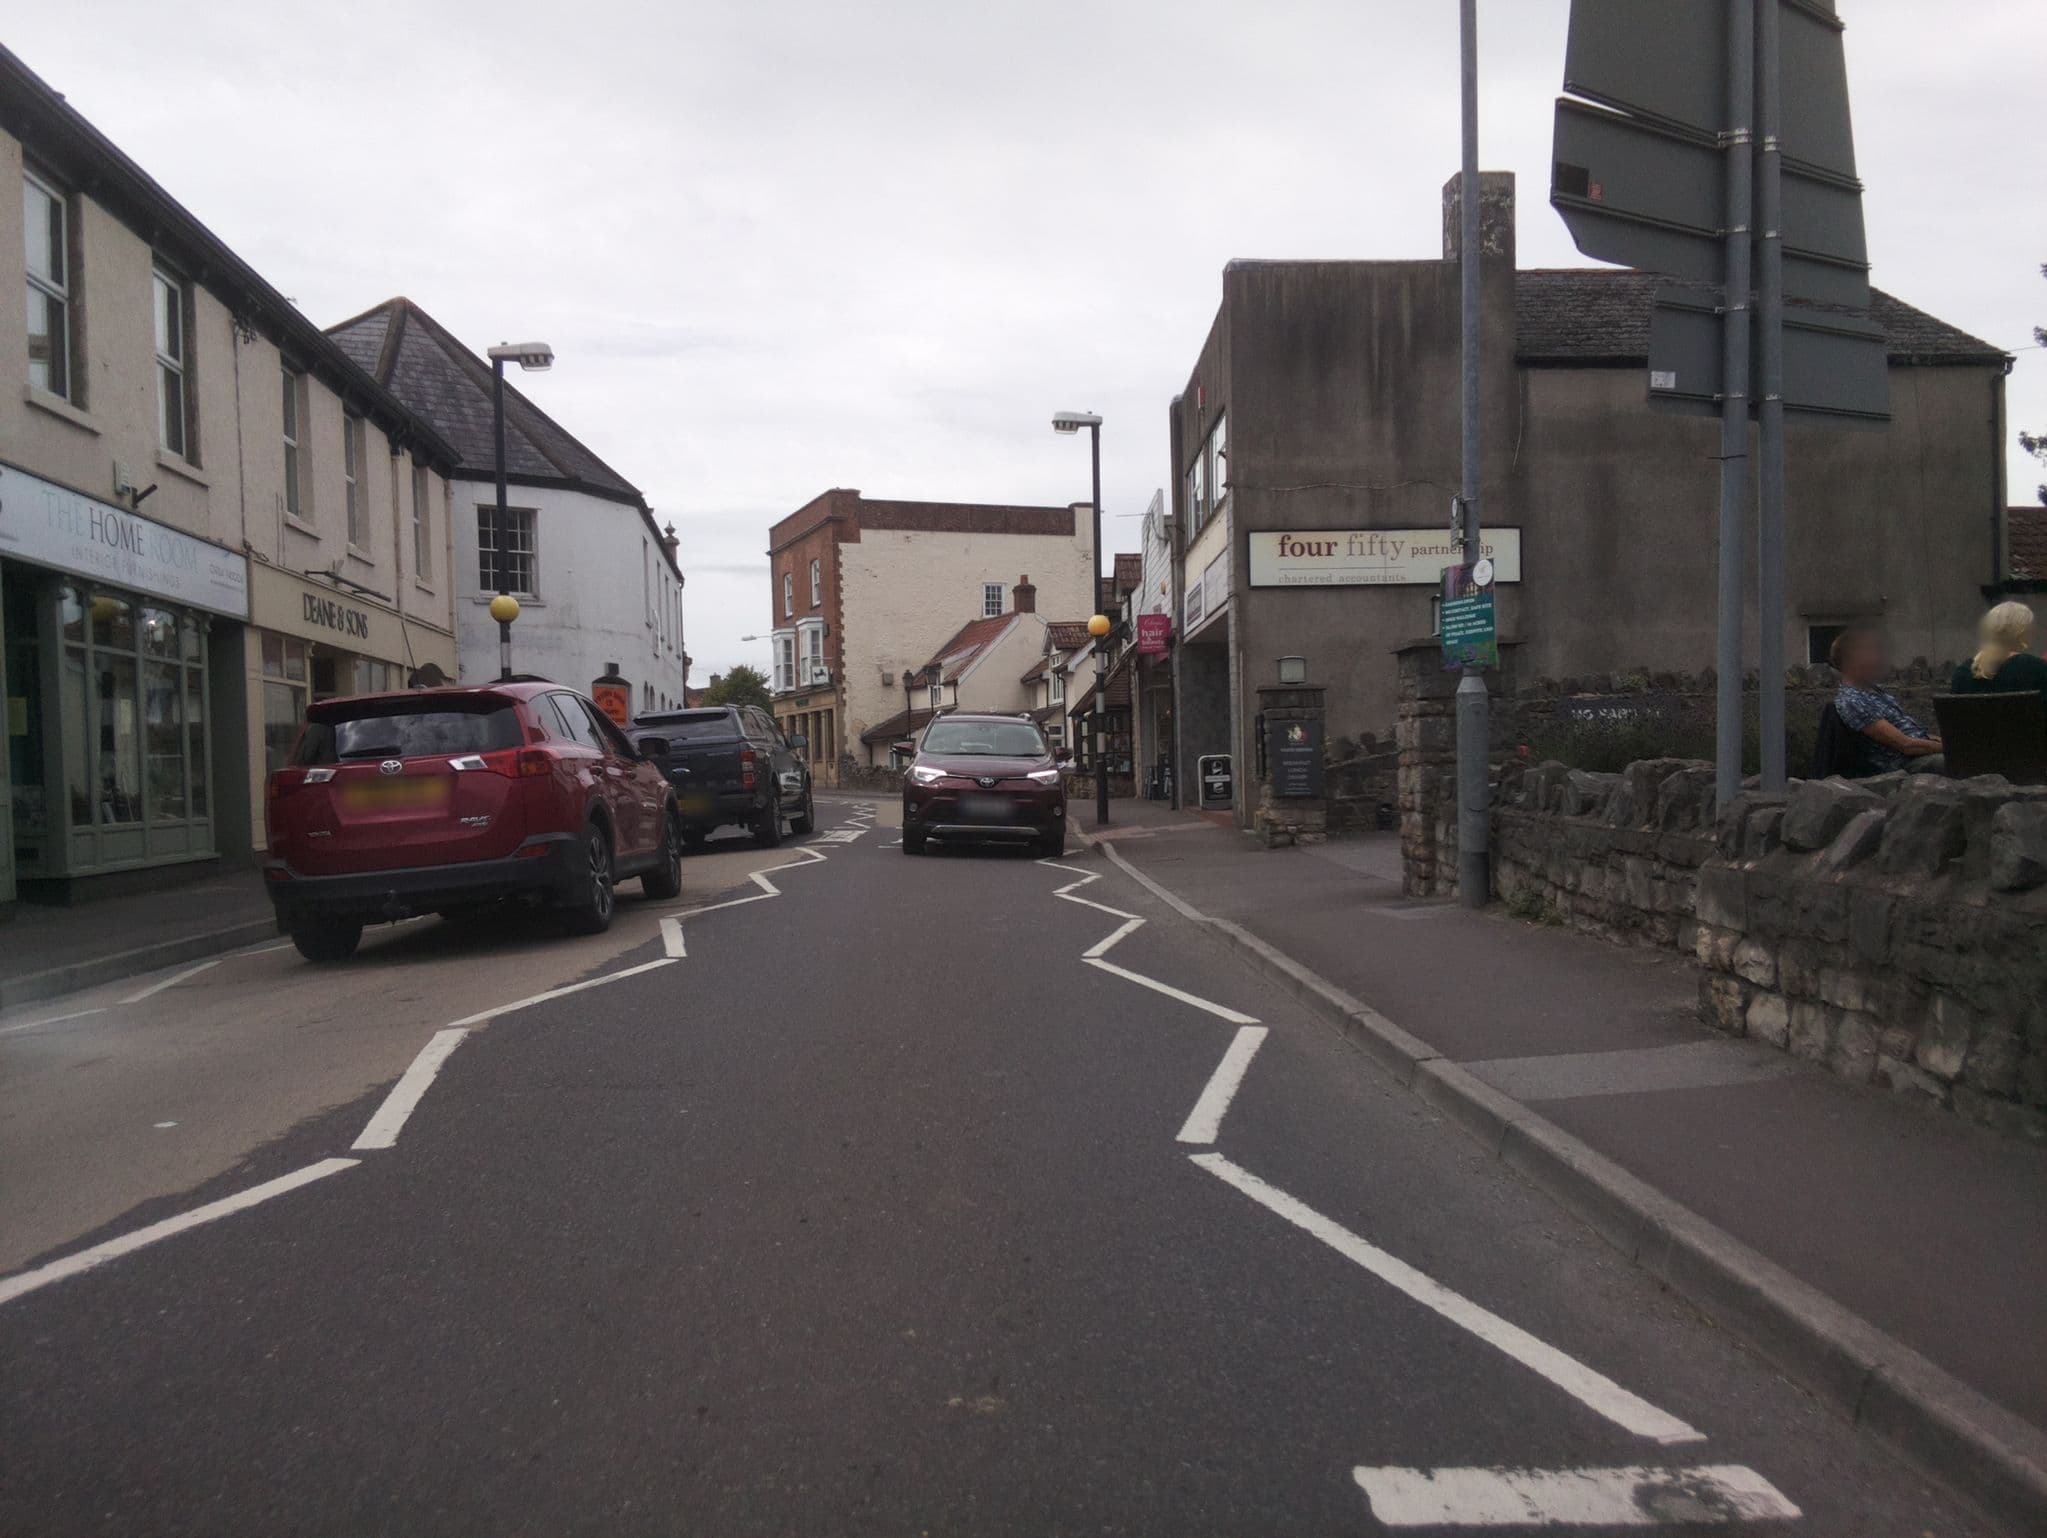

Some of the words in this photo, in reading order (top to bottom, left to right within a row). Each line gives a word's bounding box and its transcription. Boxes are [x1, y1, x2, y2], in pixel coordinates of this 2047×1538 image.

[43, 489, 83, 537] THE
[89, 506, 145, 556] HOME
[1278, 534, 1338, 557] four
[1347, 533, 1405, 560] fifty
[1411, 542, 1494, 558] partnerip
[1278, 574, 1333, 584] chartered
[1338, 573, 1407, 583] accountants
[303, 592, 337, 629] DEANE
[337, 606, 345, 632] &
[346, 609, 369, 640] SONS
[1141, 629, 1164, 638] hair
